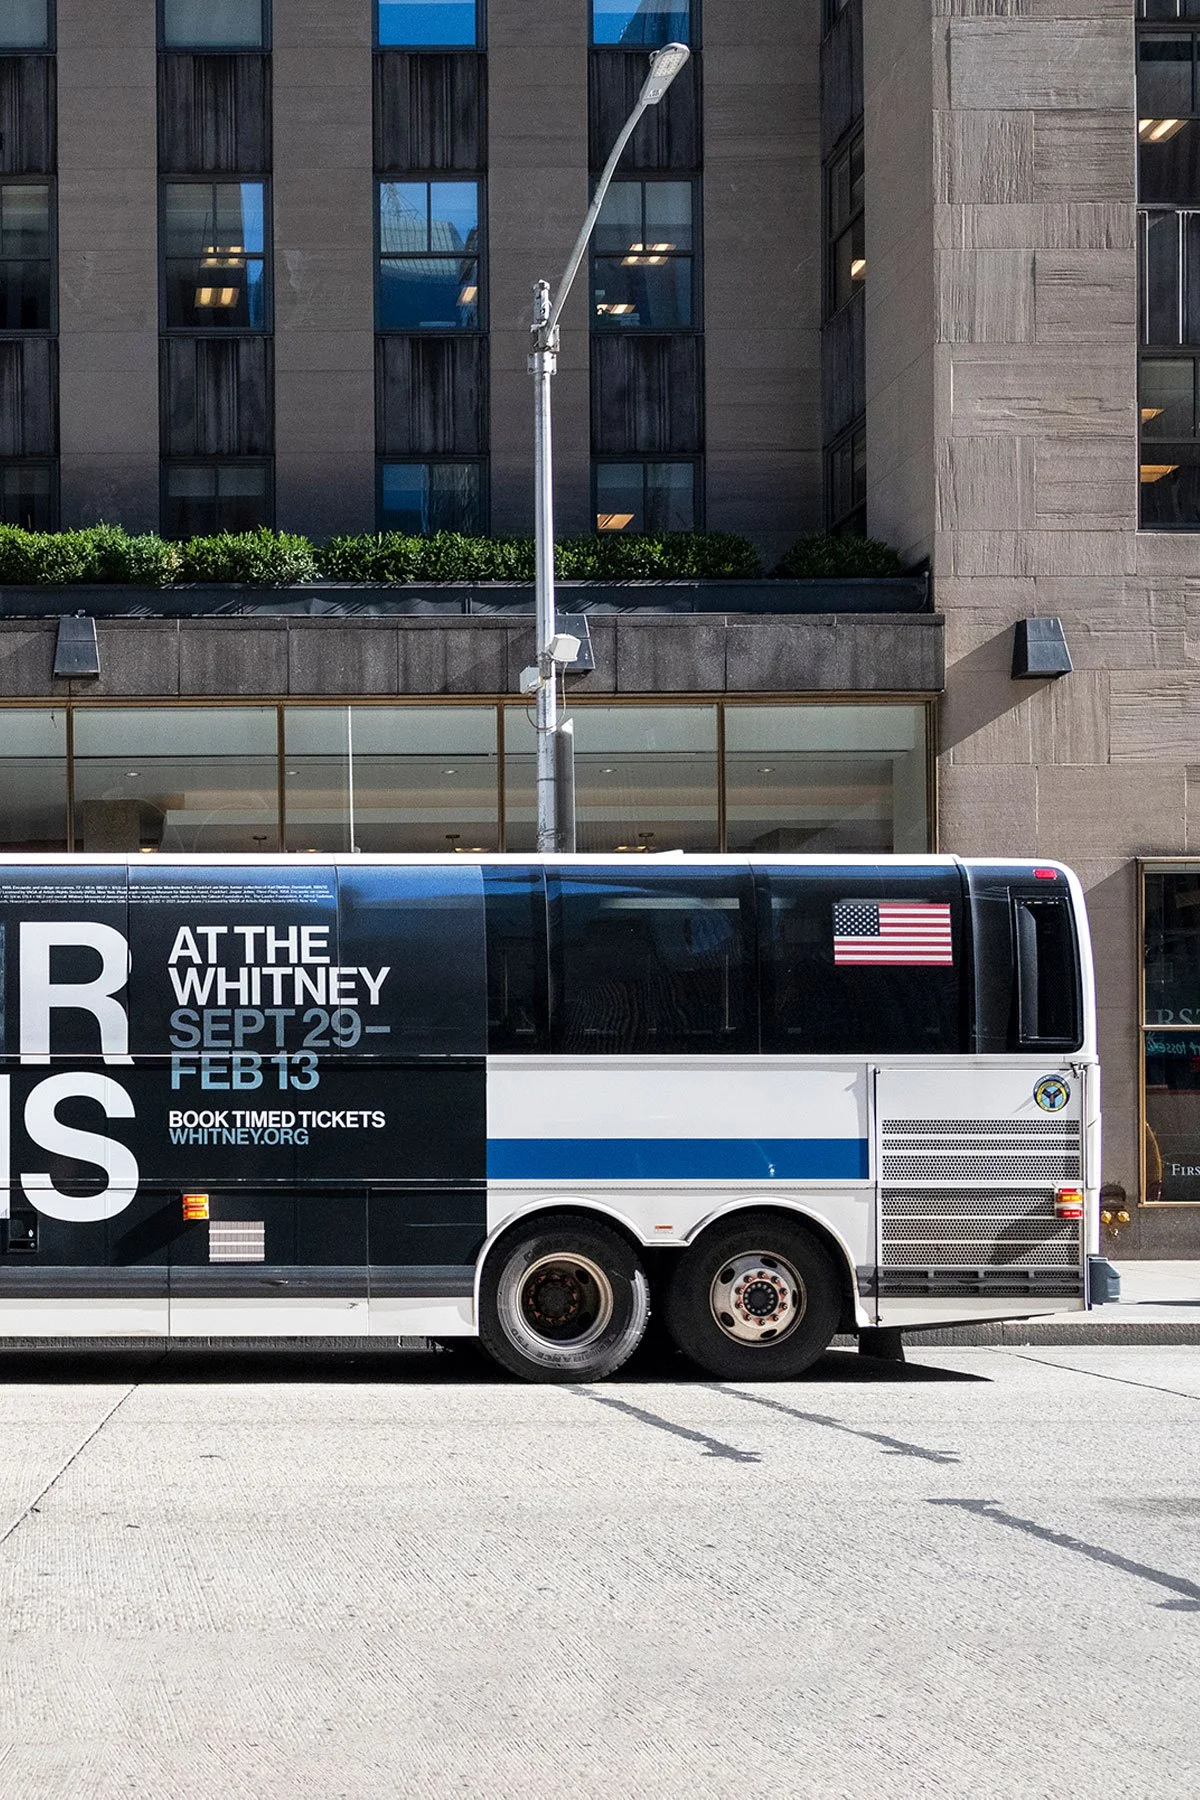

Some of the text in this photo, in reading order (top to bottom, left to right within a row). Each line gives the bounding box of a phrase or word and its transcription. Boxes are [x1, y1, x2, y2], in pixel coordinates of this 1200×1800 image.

[168, 925, 330, 964] AT THE
[168, 967, 391, 1005] WHITNEY
[169, 1008, 296, 1048] SEPT
[171, 1050, 321, 1091] FEB 13
[169, 1110, 386, 1129] BOOK TIMED TICKETS
[169, 1128, 309, 1146] WHITNEY.ORG
